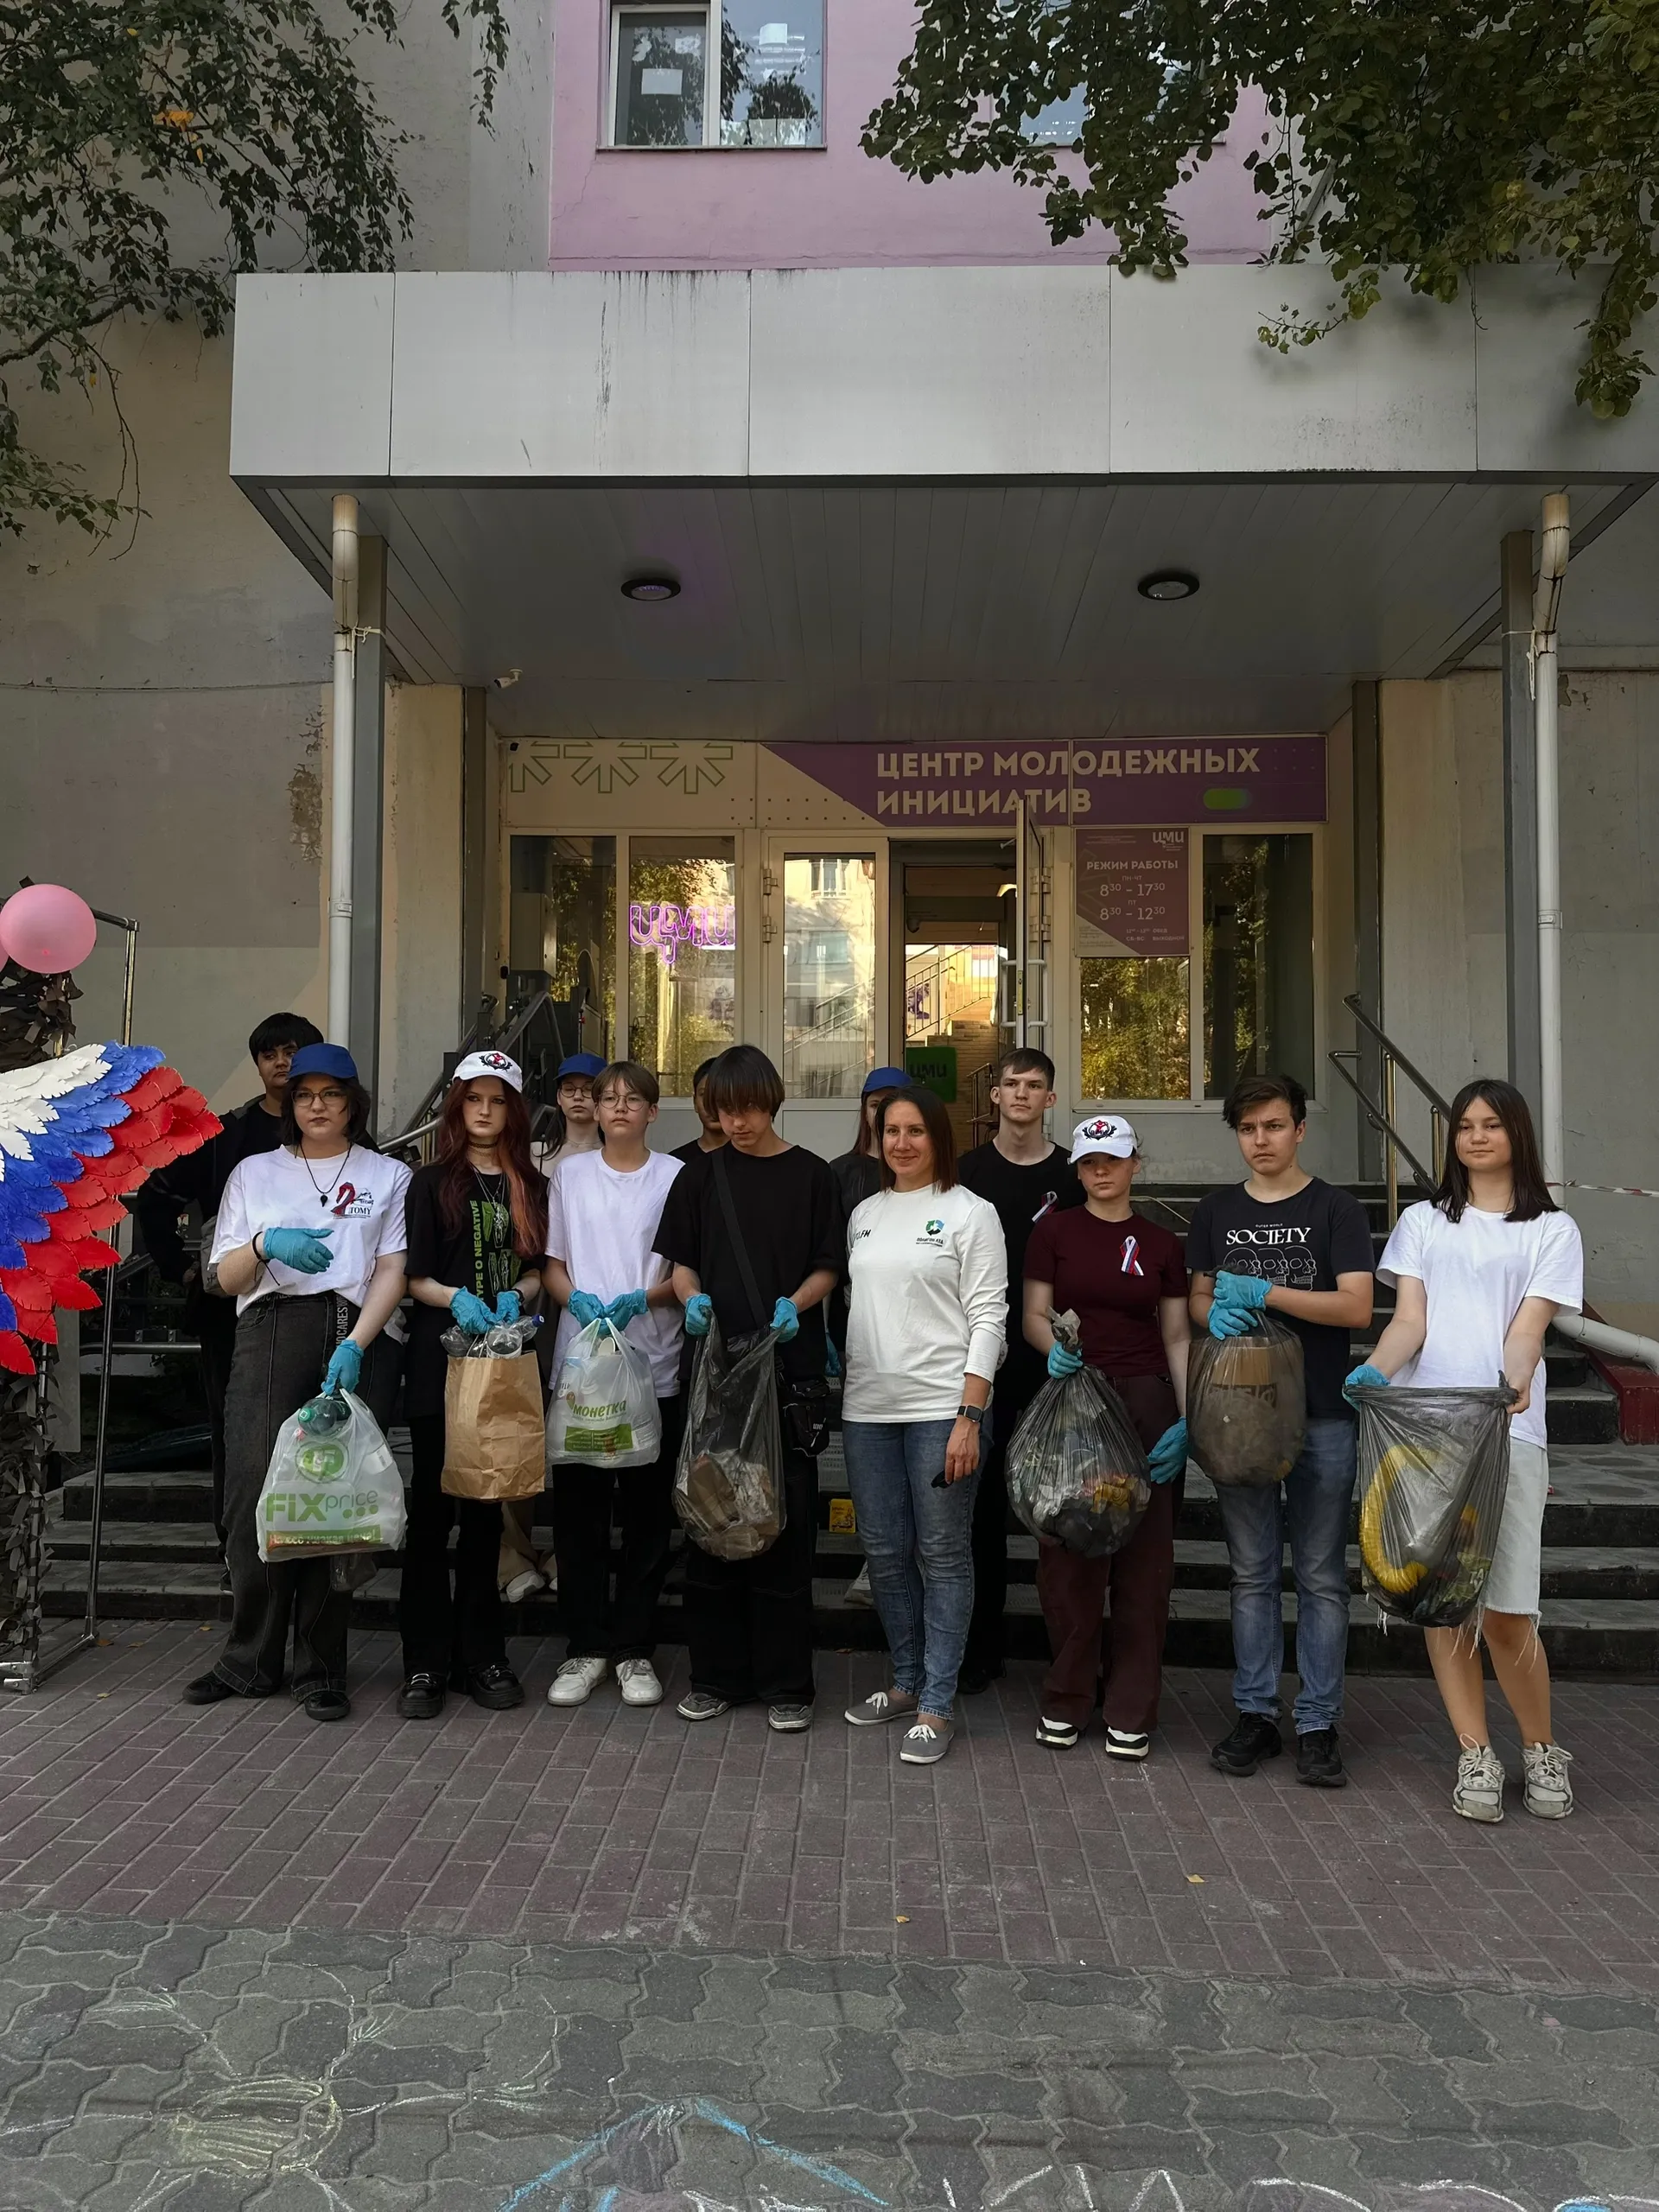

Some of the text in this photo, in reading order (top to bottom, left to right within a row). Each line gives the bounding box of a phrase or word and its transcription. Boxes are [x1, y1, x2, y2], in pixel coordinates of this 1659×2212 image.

[877, 747, 1261, 779] ЦЕНТР МОЛОДЕЖНЫХ
[1086, 860, 1179, 870] РЕЖИМ РАБОТЫ
[469, 1200, 483, 1257] NEGATIVE
[1226, 1227, 1312, 1245] SOCIETY
[475, 1273, 484, 1300] YPE
[325, 1490, 378, 1512] price
